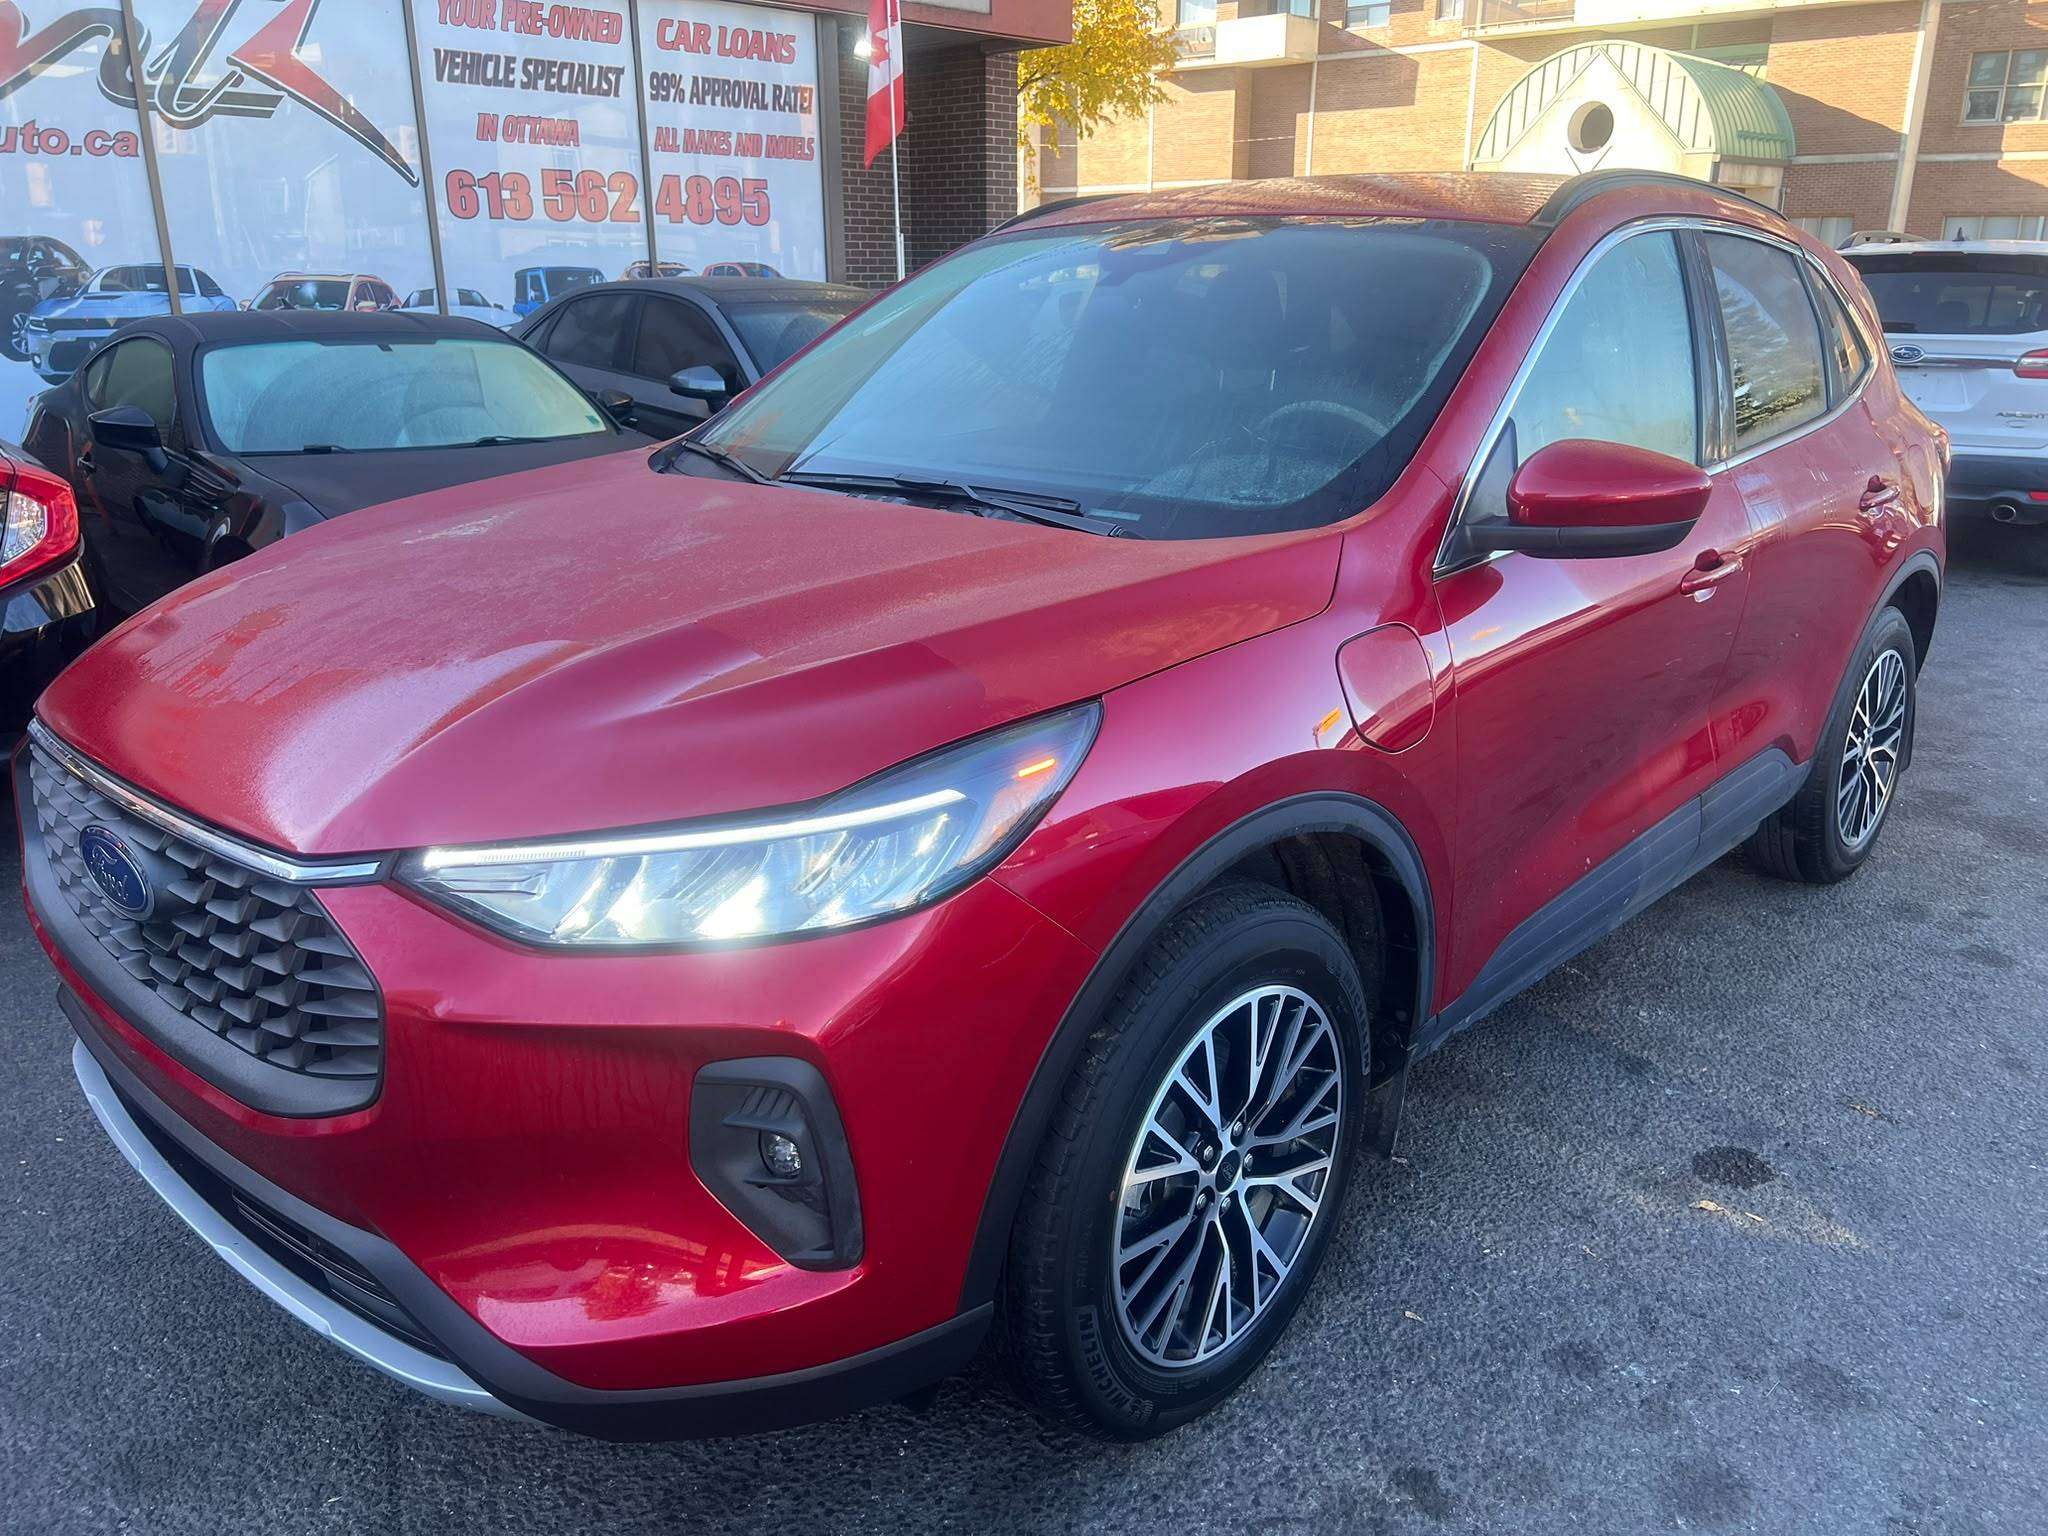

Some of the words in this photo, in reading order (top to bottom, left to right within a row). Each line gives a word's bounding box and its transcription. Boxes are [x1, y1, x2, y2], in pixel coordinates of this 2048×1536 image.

[437, 0, 496, 31] YOUR
[500, 0, 623, 45] PRE-OWNED
[656, 18, 712, 55] CAR
[717, 25, 797, 64] LOANS
[433, 48, 517, 89] VEHICLE
[520, 57, 625, 98] SPECIALIST
[649, 71, 686, 104] 99%
[689, 75, 769, 112] APPROVAL
[772, 83, 815, 115] RATE!
[476, 112, 499, 142] IN
[502, 114, 580, 148] OTTAWA
[654, 126, 681, 154] ALL
[682, 128, 732, 157] MAKES
[734, 132, 763, 158] AND
[765, 134, 815, 162] MODELS
[445, 169, 534, 221] 613
[541, 168, 640, 224] 562
[655, 174, 771, 227] 4895
